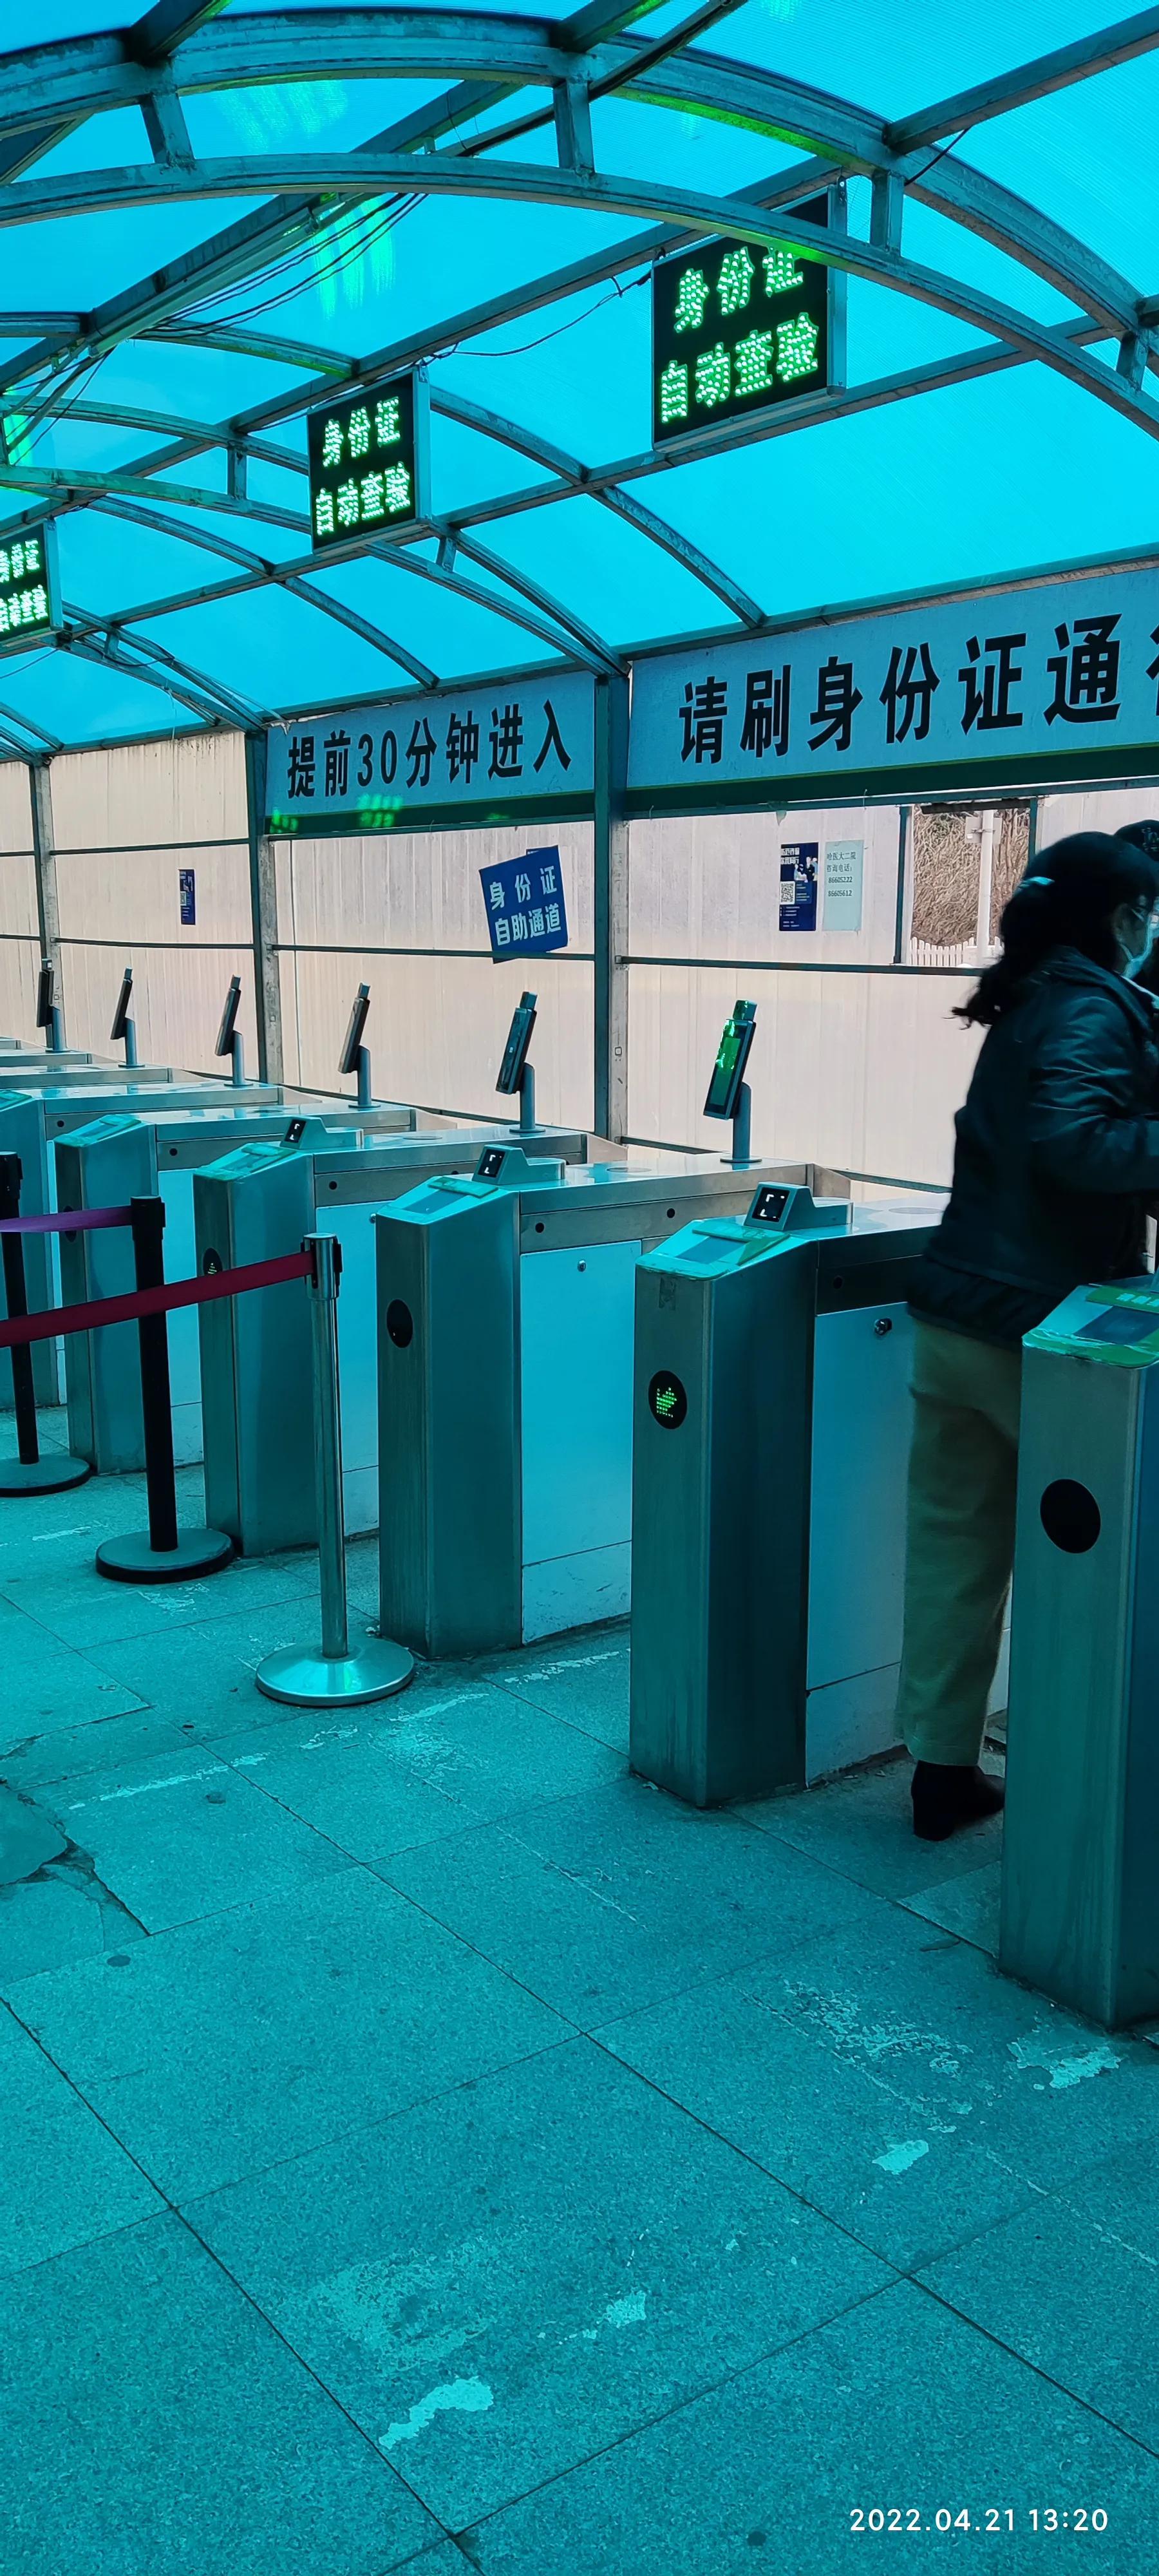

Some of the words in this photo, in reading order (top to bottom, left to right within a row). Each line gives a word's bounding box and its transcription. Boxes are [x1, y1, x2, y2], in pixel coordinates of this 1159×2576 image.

[674, 246, 803, 333] 身份证
[661, 312, 819, 423] 自动查验
[323, 396, 400, 467] 身份证
[316, 462, 411, 536] 自动查验
[679, 613, 1159, 764] 请刷身份证通
[287, 699, 572, 799] 提前30分钟进入
[489, 866, 557, 910] 身份证
[495, 903, 561, 945] 自助通道
